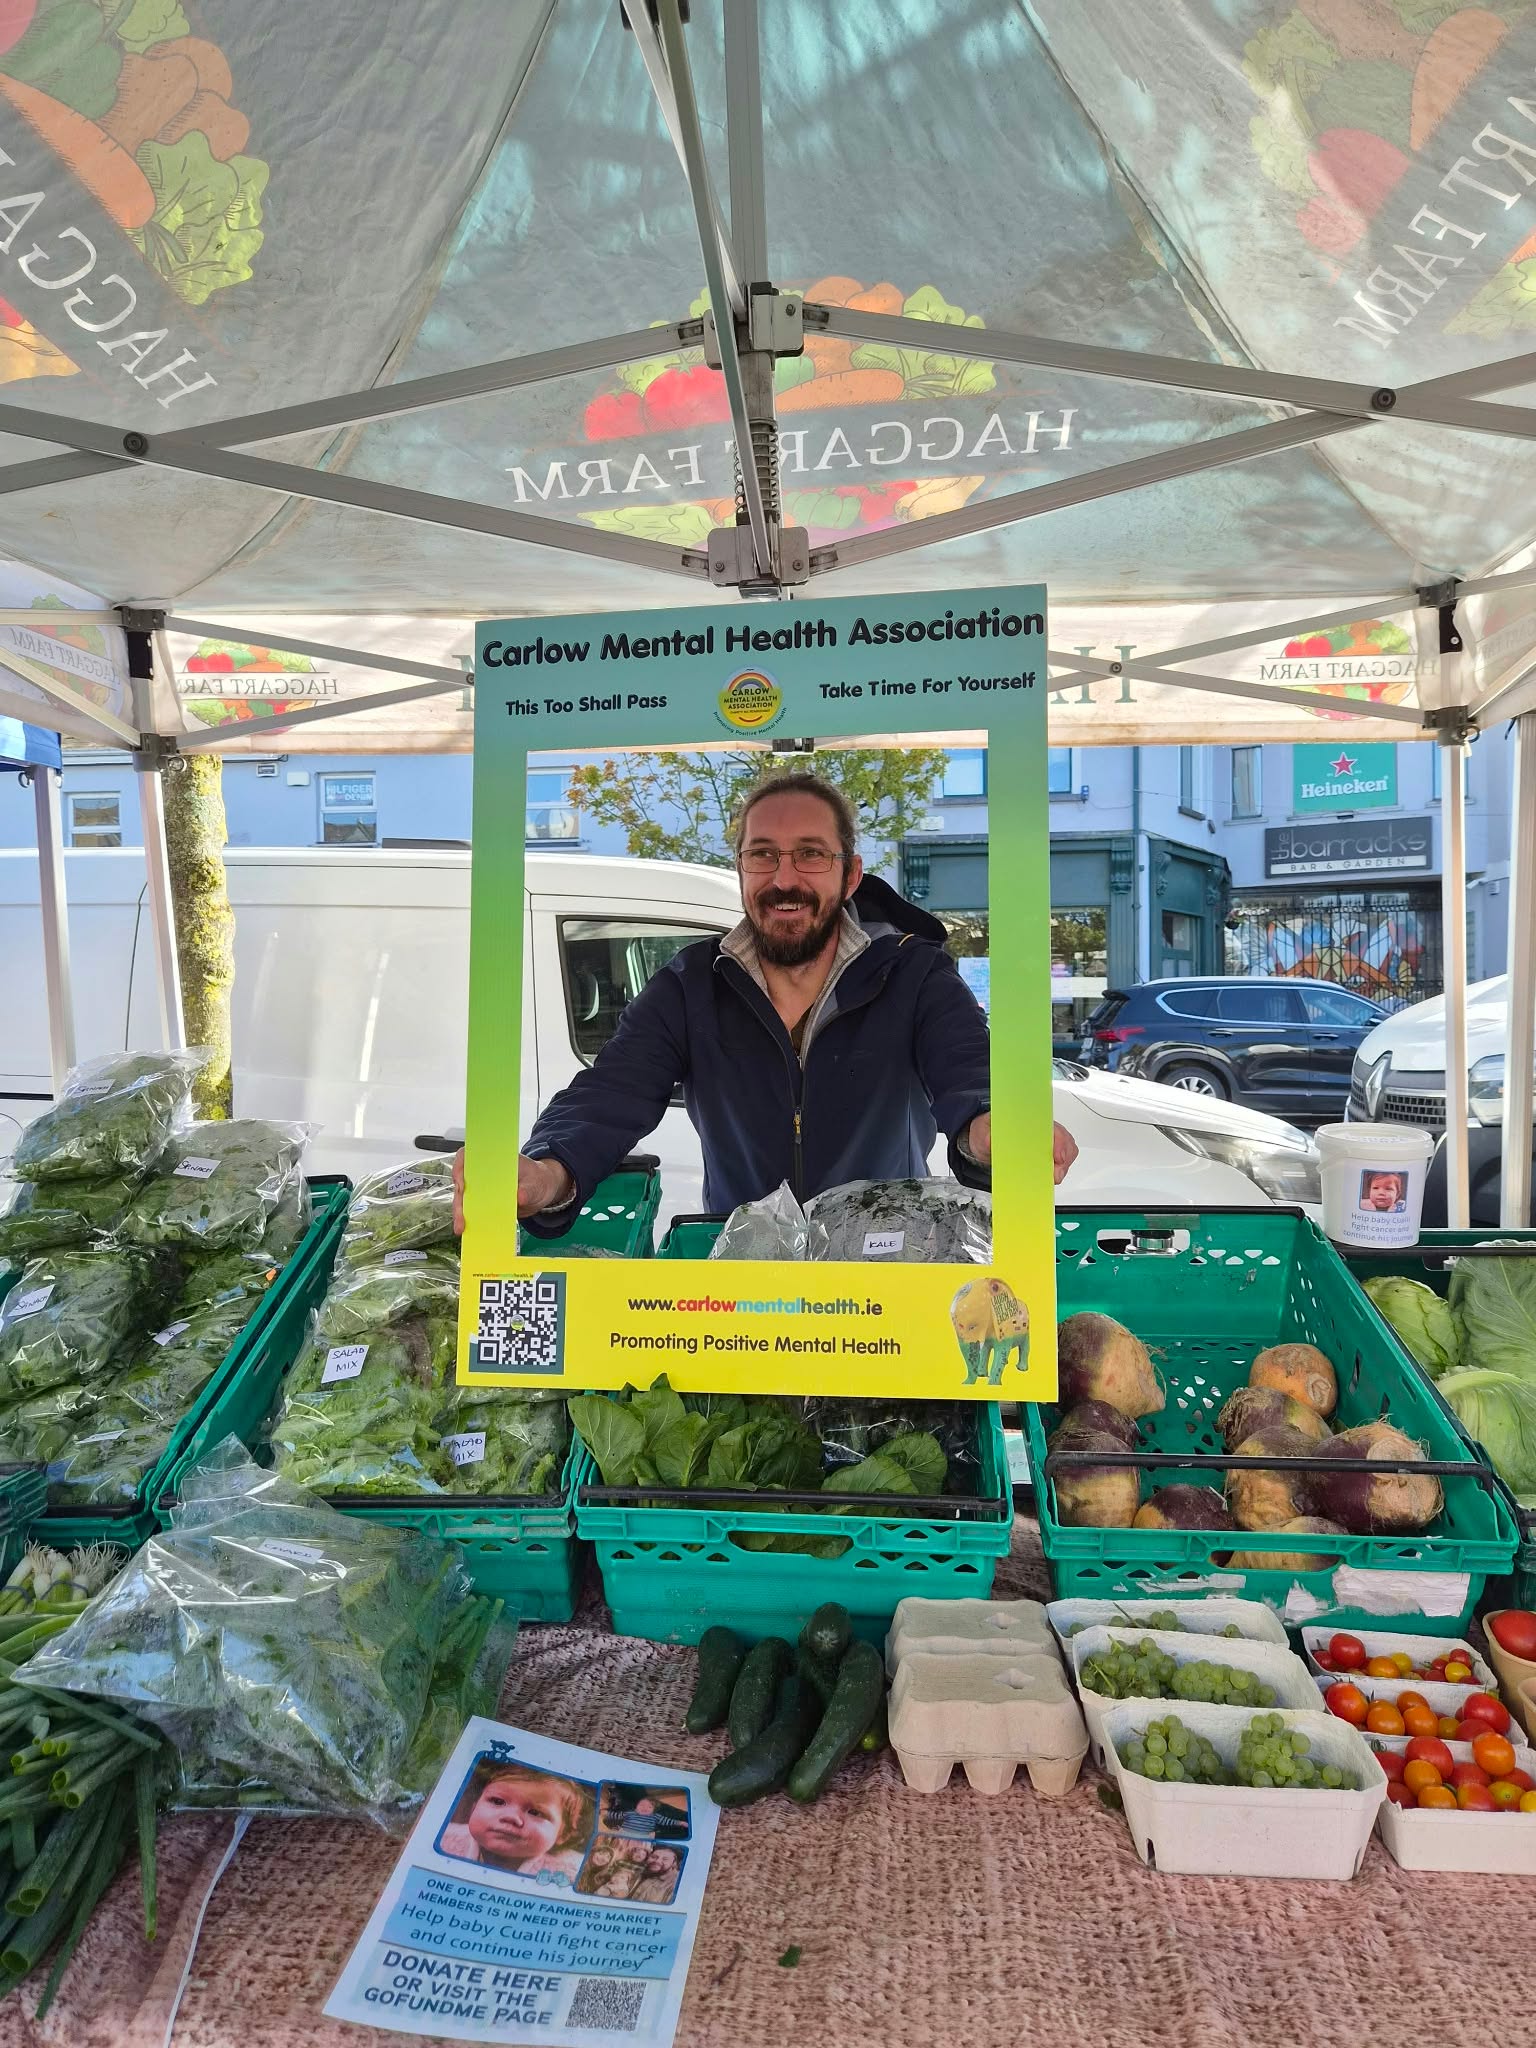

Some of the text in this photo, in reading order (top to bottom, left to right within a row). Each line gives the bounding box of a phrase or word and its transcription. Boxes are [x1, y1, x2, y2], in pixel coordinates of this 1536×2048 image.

[483, 607, 1044, 668] Carlow Mental Health Association
[732, 687, 769, 696] CARLOW
[819, 672, 1036, 699] Take Time For Yourself
[505, 694, 667, 716] This Too Shall Pass
[1301, 778, 1388, 798] Heineken
[1290, 823, 1427, 859] barracks
[1290, 858, 1405, 872] BAR & GARDEN
[1351, 1212, 1370, 1222] Help
[1371, 1216, 1391, 1225] baby
[1351, 1221, 1369, 1231] fight
[869, 1240, 897, 1249] KALE
[1343, 1230, 1376, 1241] continue
[628, 1296, 883, 1316] www.carlowmentalhealth.ie
[332, 1347, 365, 1359] SALAD
[610, 1333, 901, 1355] Promoting Positive Mental Health
[336, 1360, 358, 1372] MIX
[418, 1890, 661, 1937] MEMBERS IS IN NEED OF YOUR HELP
[427, 1879, 662, 1926] ONE OF CARLOW FARMERS MARKET
[401, 1903, 668, 1954] Help baby Cualli fight cancer
[410, 1927, 648, 1972] and continue his journey
[383, 1950, 562, 1992] DONATE HERE
[392, 1974, 538, 2008] OR VISIT THE
[364, 1986, 553, 2025] GOFUNDME PAGE
